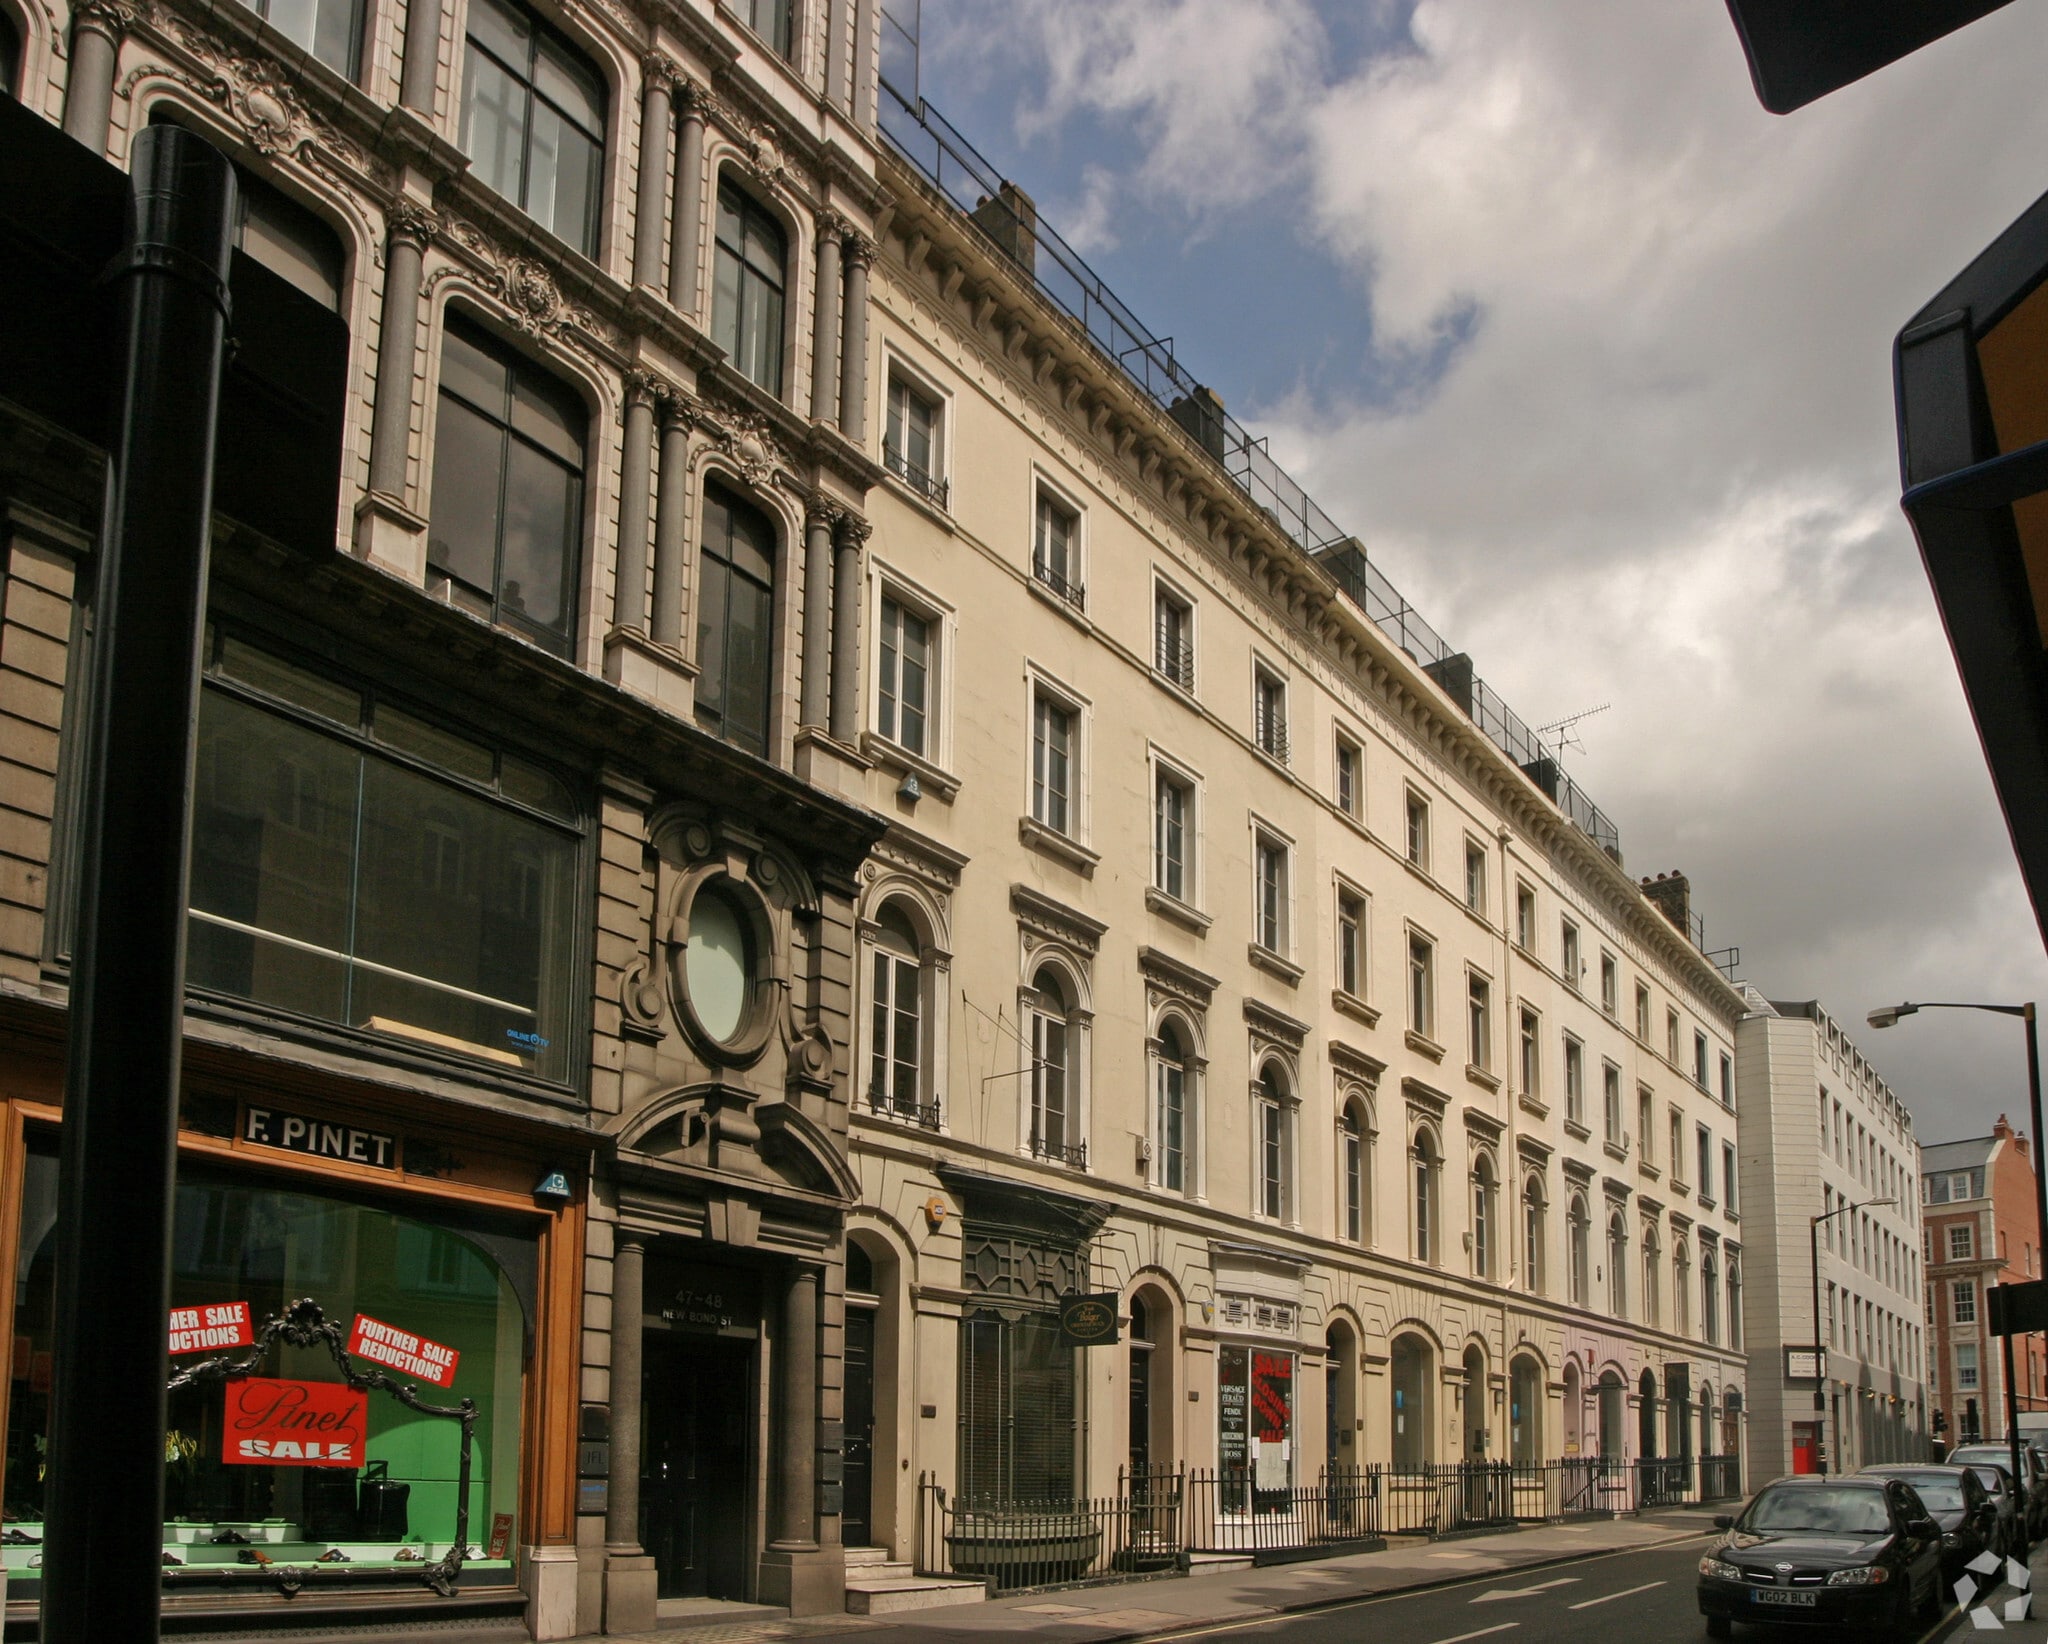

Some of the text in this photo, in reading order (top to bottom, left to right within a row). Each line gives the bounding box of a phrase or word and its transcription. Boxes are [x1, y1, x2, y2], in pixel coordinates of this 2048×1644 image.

[247, 1108, 392, 1166] F. PINET
[170, 1305, 244, 1331] HER SALE
[663, 1308, 733, 1326] NEW BOND ST
[169, 1325, 240, 1351] UCTIONS
[358, 1319, 455, 1367] FURTHER SALE
[358, 1337, 443, 1382] REDUCTIONS
[1254, 1354, 1292, 1379] SALE
[1220, 1384, 1246, 1394] VERSACE
[234, 1382, 360, 1434] Pinet
[1252, 1393, 1283, 1430] DOWN
[1259, 1429, 1285, 1442] SALE
[238, 1439, 352, 1461] SALE
[1758, 1590, 1814, 1605] WG02 BLK
